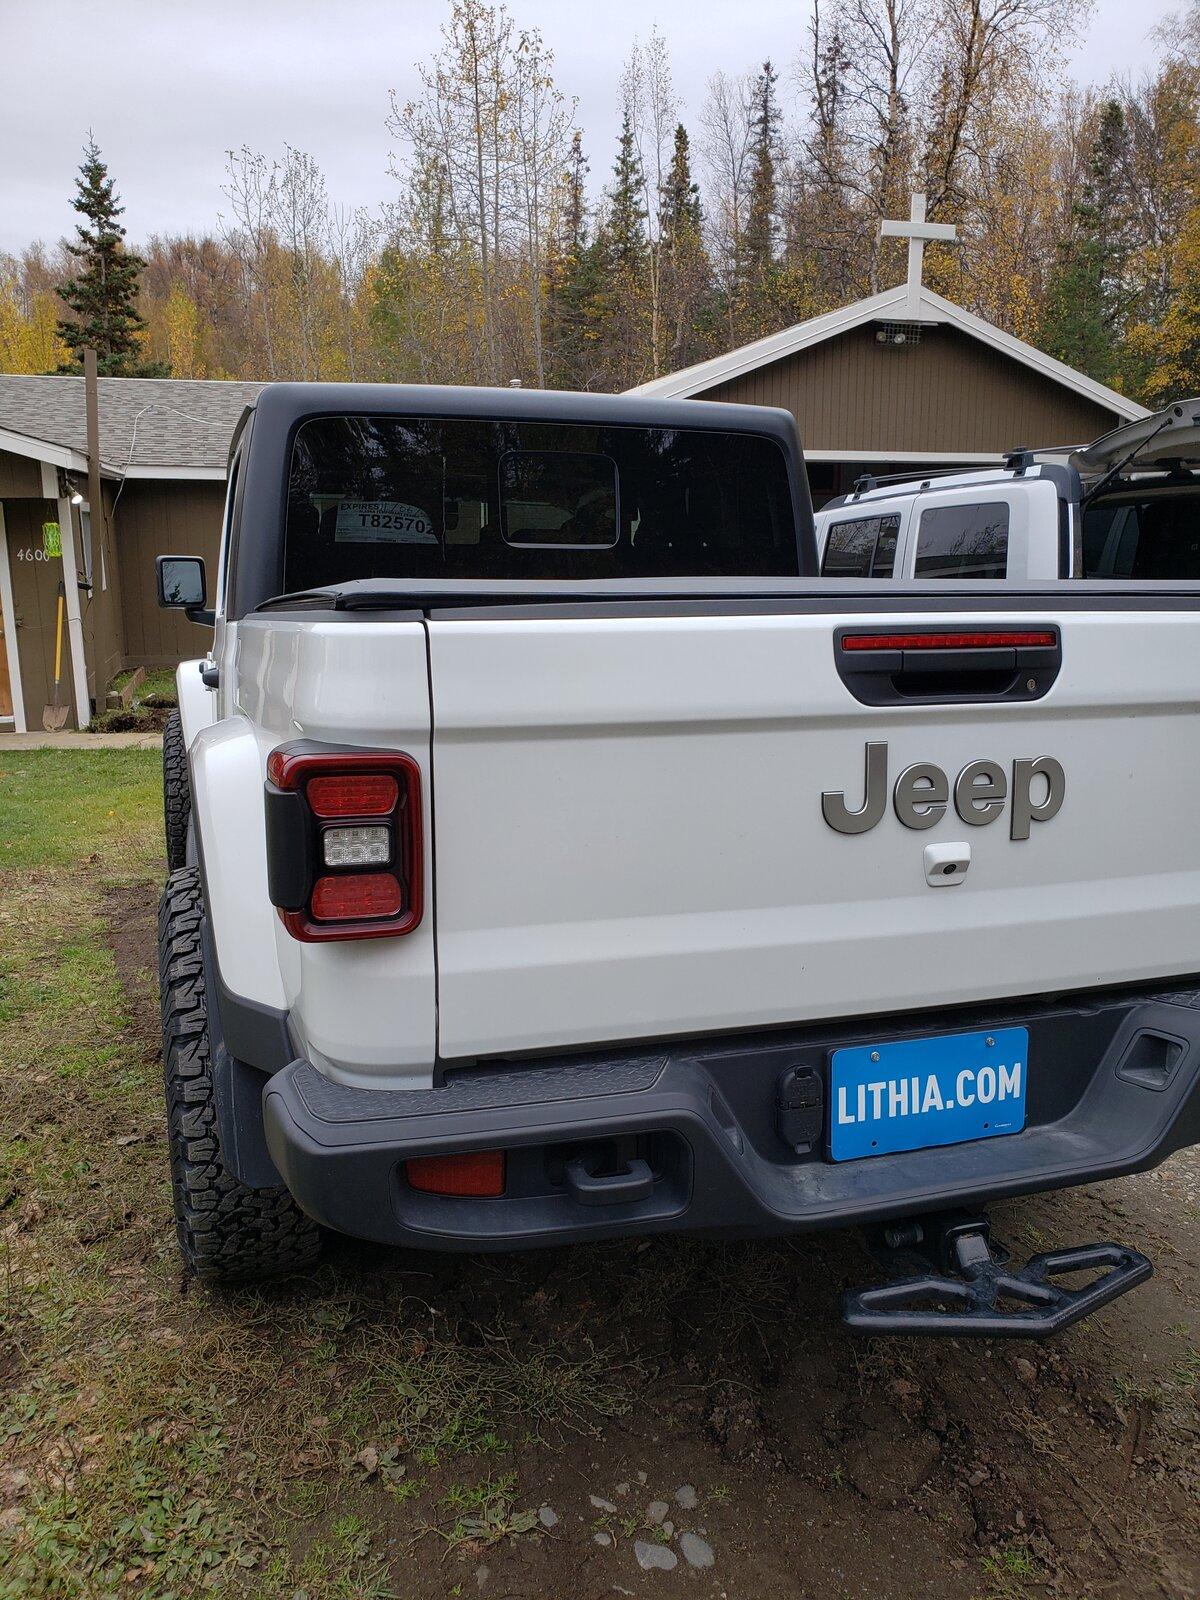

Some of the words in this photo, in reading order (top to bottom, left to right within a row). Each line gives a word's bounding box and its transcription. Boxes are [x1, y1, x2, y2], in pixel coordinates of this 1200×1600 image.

[340, 503, 380, 511] EXPIRES
[358, 513, 435, 535] T825702
[821, 740, 1066, 840] Jeep
[838, 1062, 1021, 1124] LITHIA.COM
